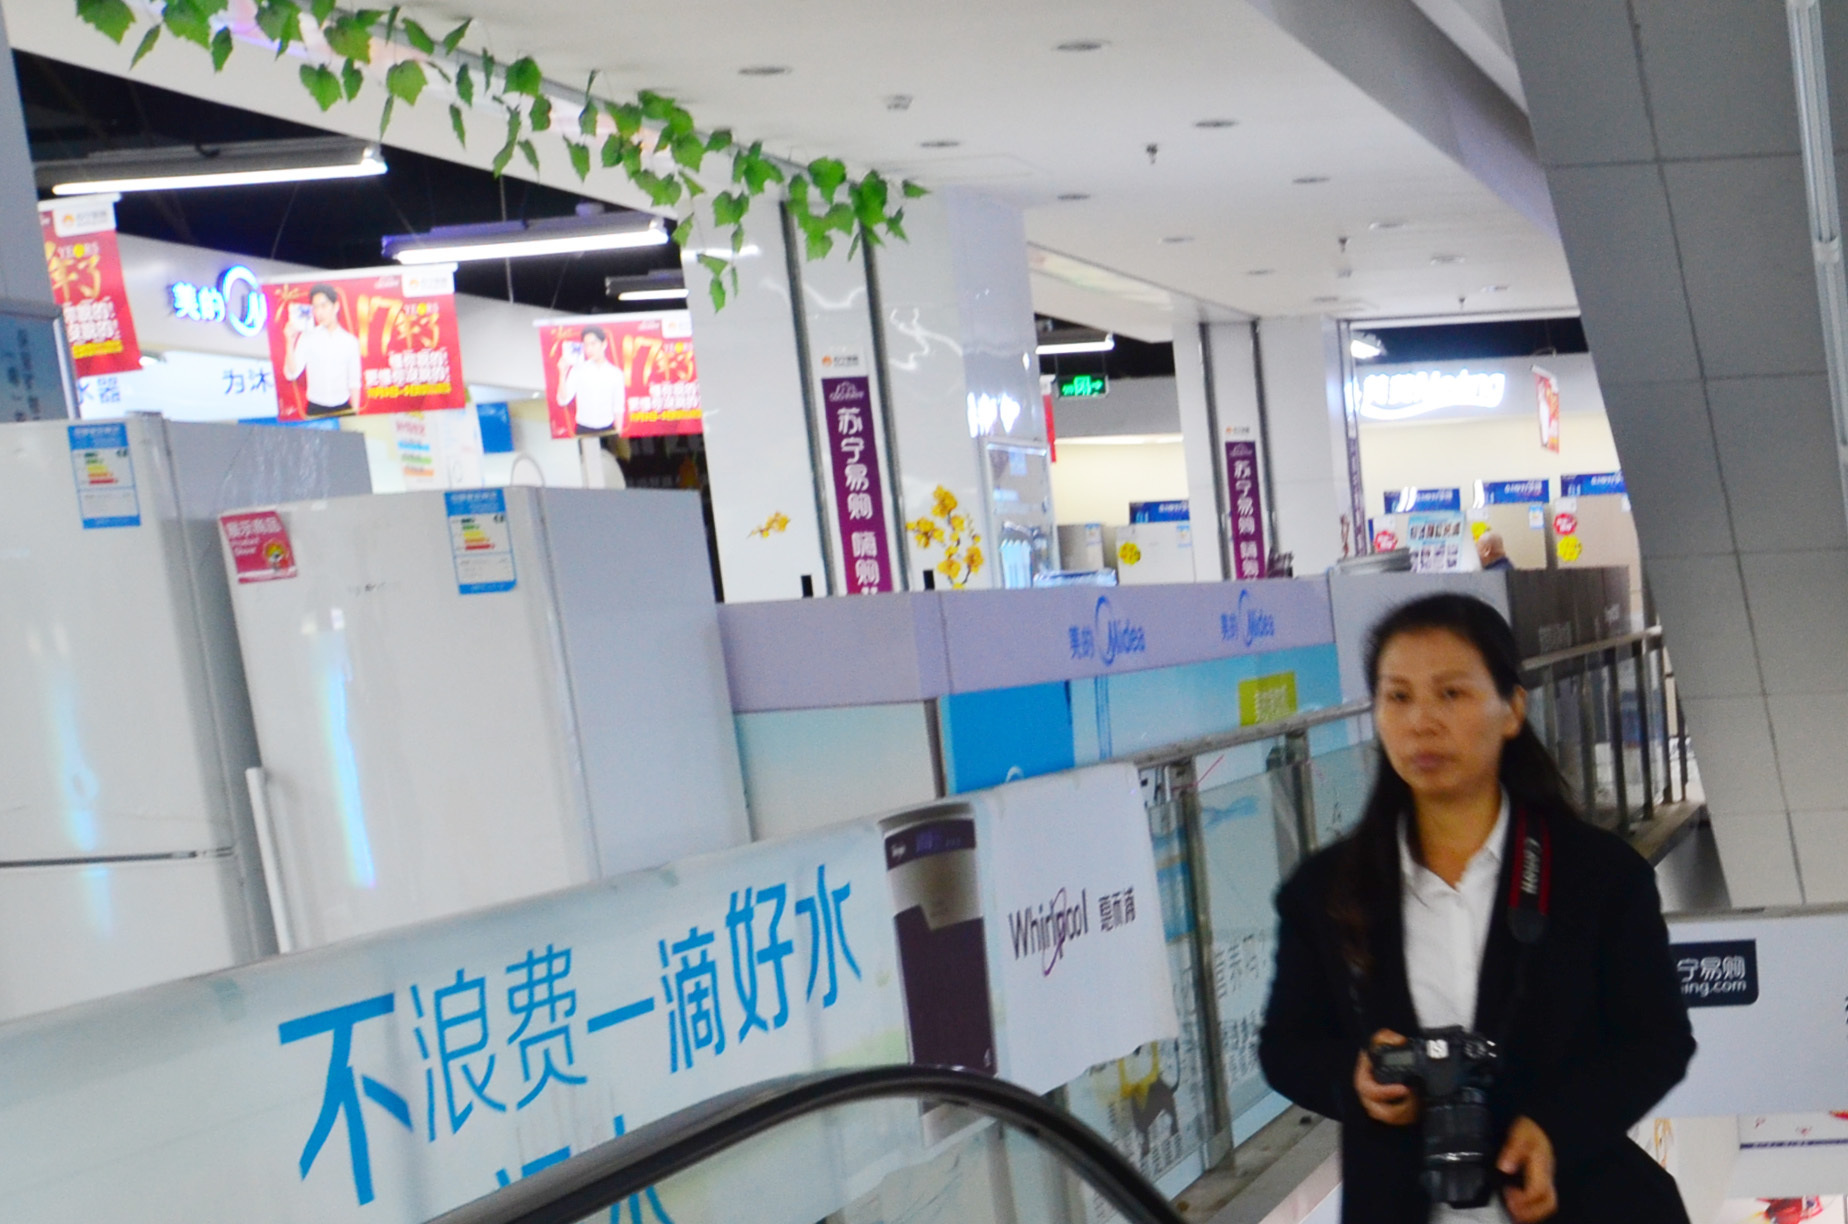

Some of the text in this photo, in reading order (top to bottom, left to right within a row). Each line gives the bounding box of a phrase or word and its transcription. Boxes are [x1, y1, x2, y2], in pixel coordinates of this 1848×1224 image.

[837, 406, 873, 520] 苏宁易购
[851, 531, 880, 594] 嗨购
[1008, 888, 1089, 964] Whirlpool
[1677, 955, 1746, 983] 宁易购
[277, 864, 863, 1207] 不浪费一滴好水
